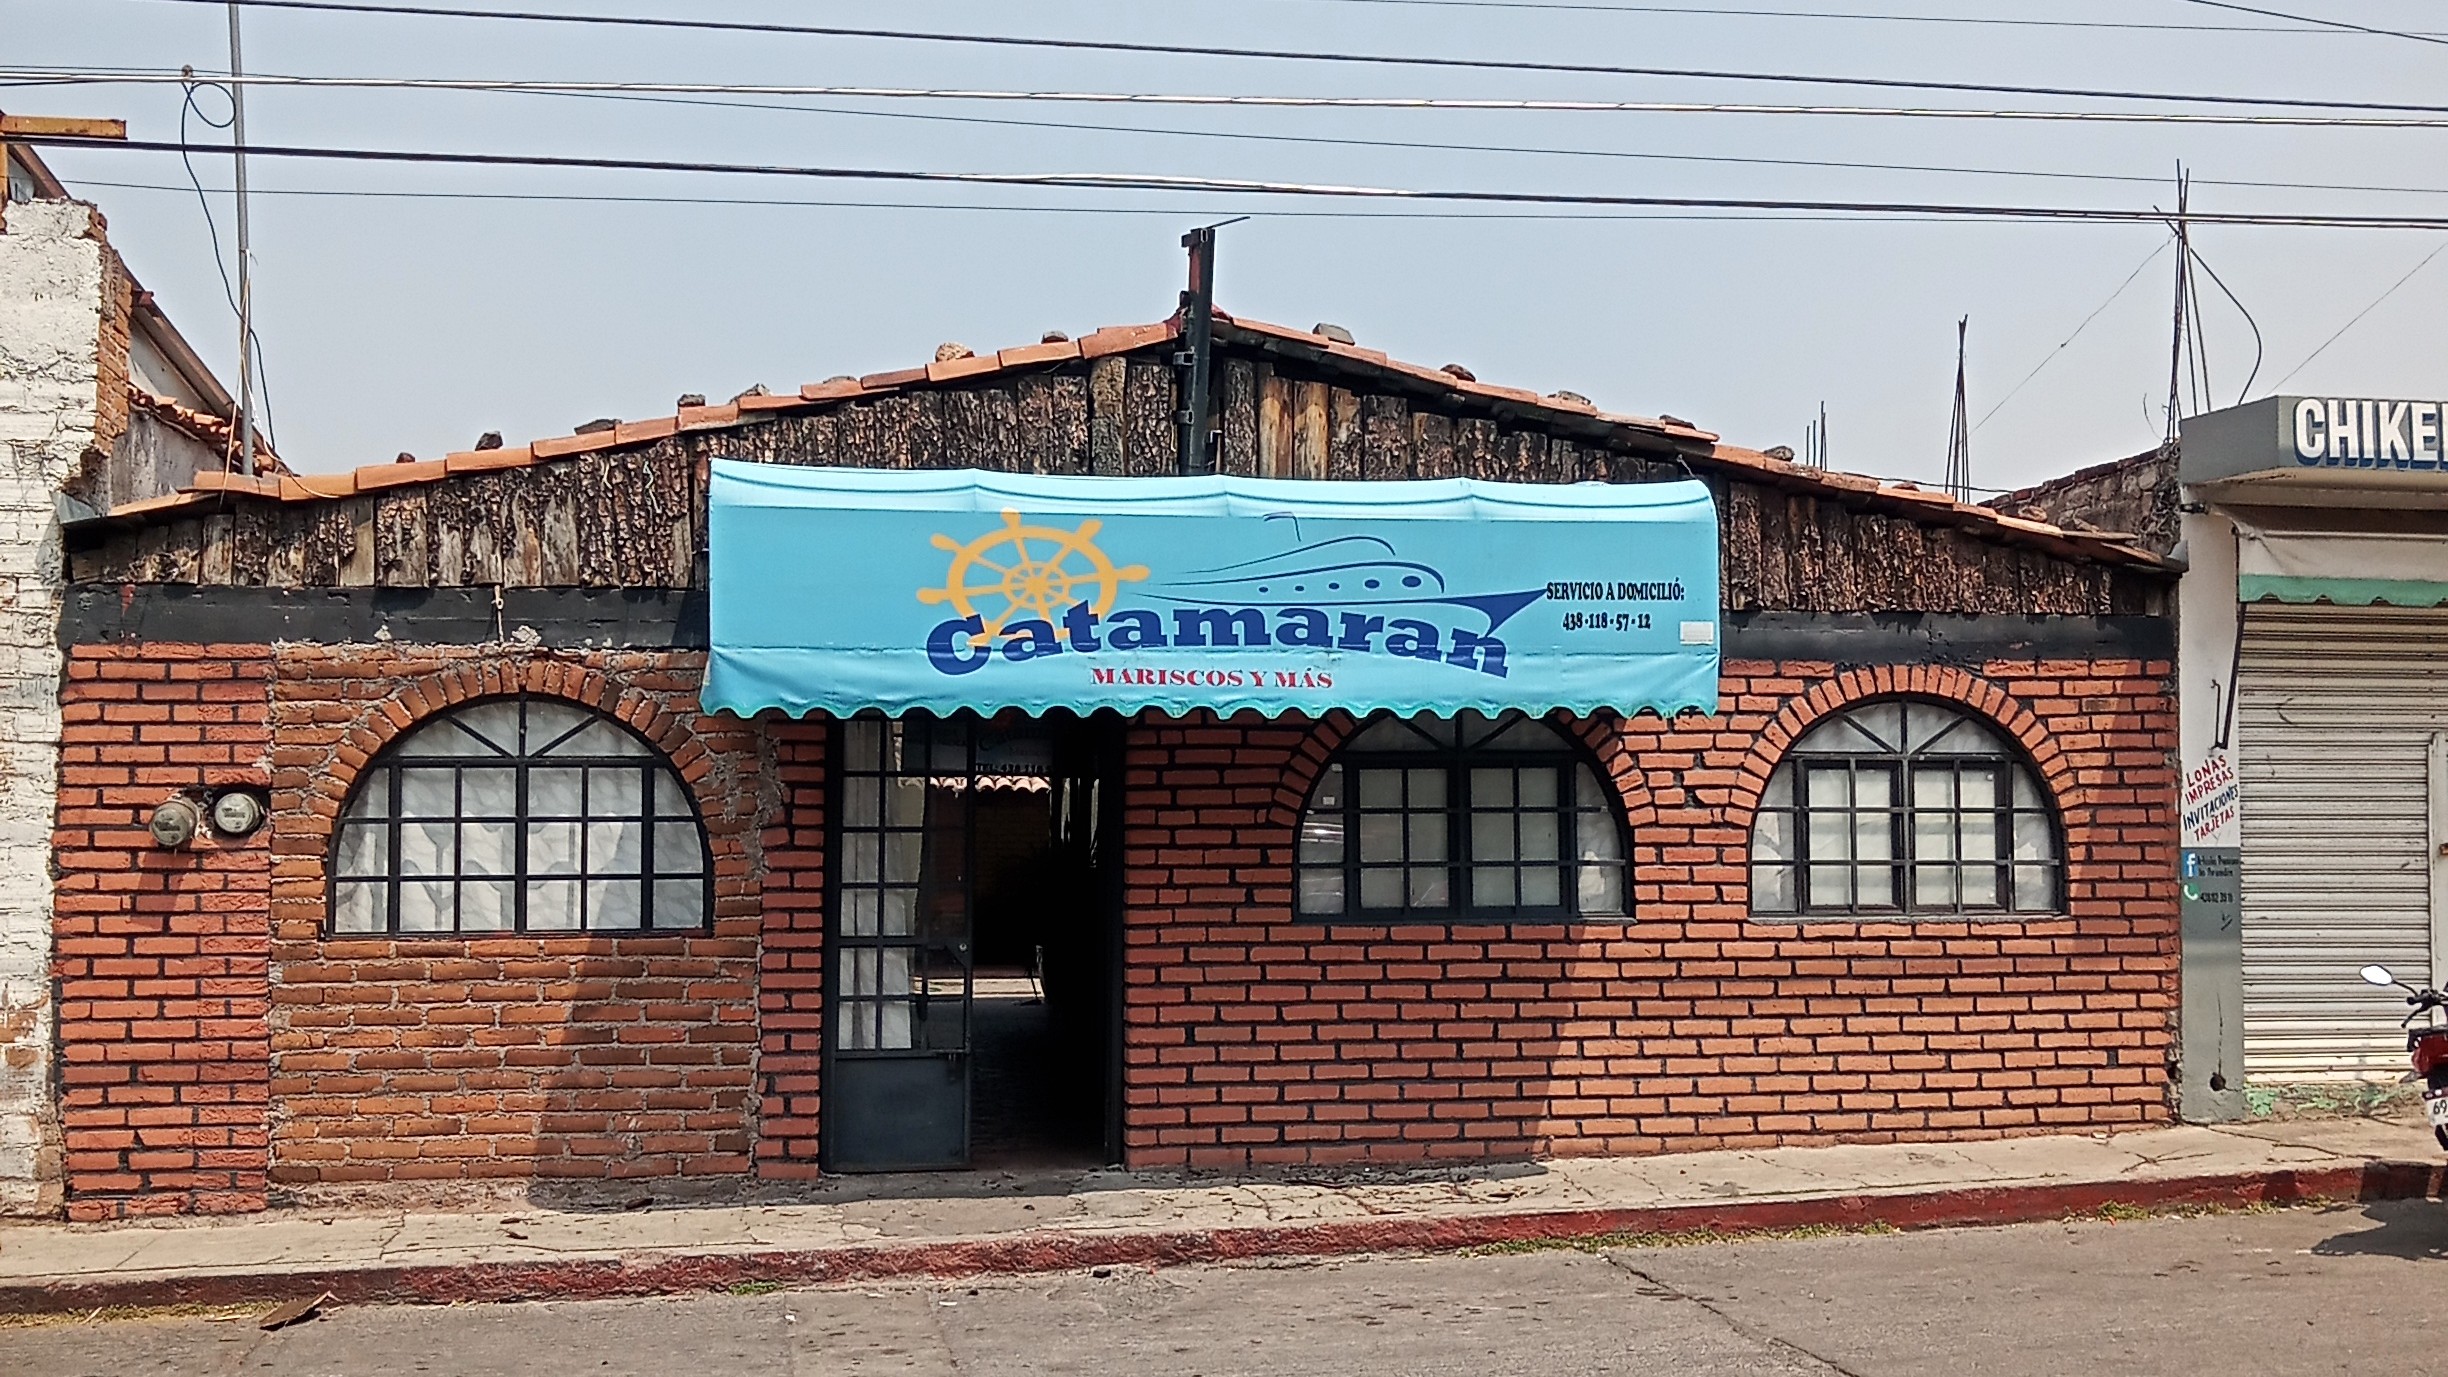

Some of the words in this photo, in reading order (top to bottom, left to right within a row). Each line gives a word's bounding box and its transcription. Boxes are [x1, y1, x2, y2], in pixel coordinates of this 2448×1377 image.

[2294, 397, 2448, 468] CHIKE
[1546, 581, 1603, 601] SERVICIO
[1606, 581, 1616, 601] A
[1090, 668, 1244, 687] MARISCOS
[1249, 670, 1268, 688] Y
[1274, 667, 1333, 689] MÁS
[2184, 767, 2234, 806] IMPRESAS
[2185, 754, 2227, 788] LONAS
[2182, 783, 2239, 832] INVITACIONES
[2193, 805, 2235, 842] TARJETAS
